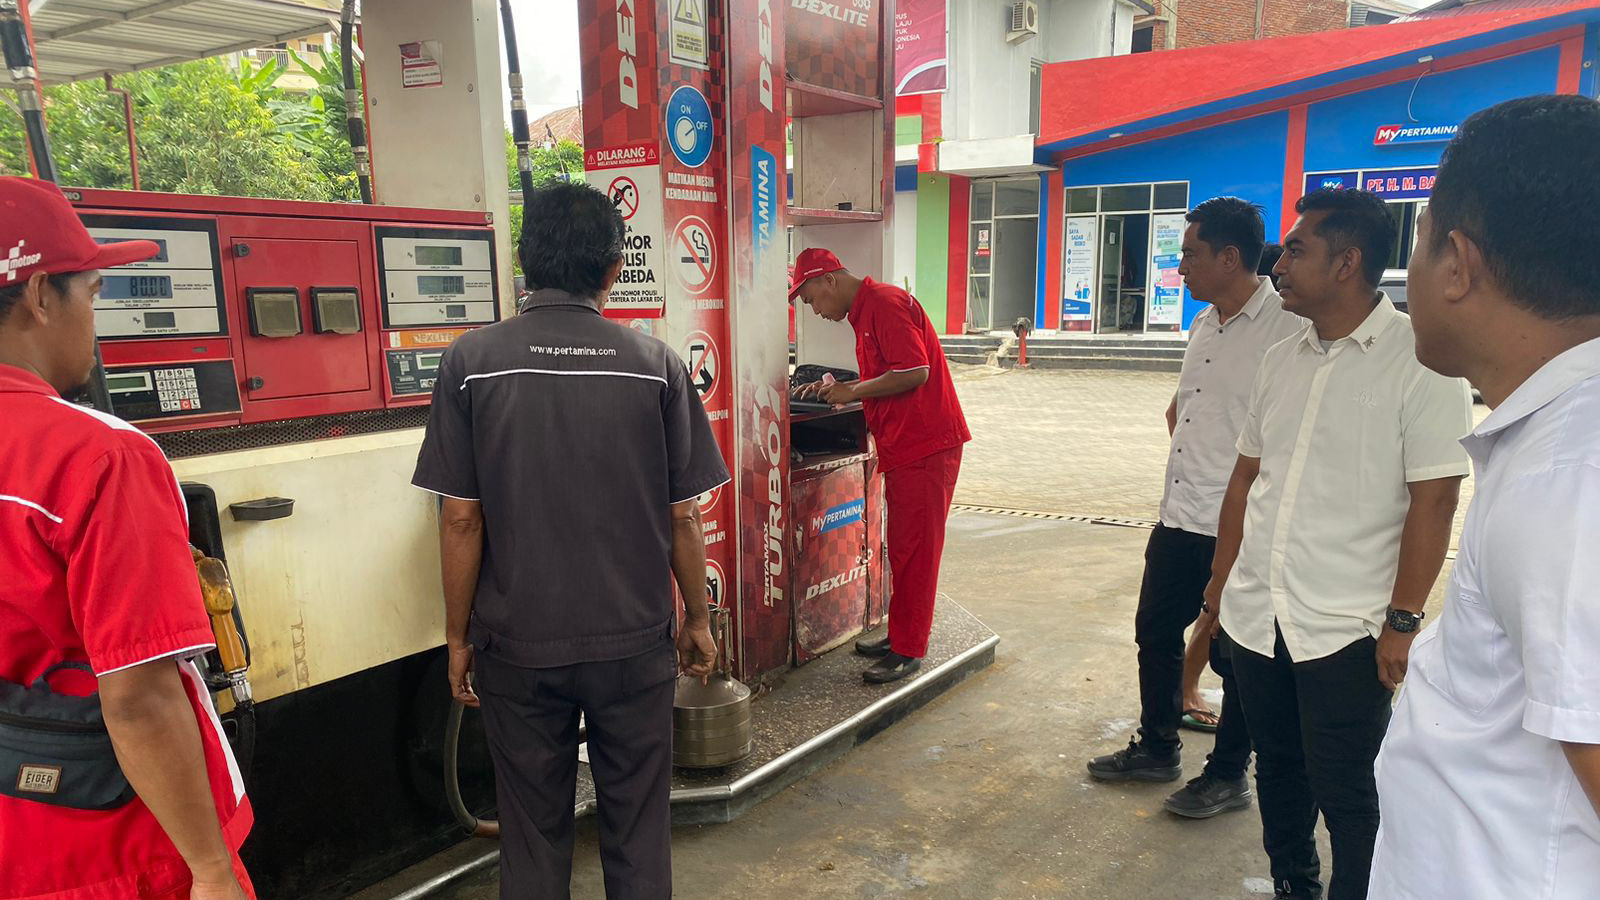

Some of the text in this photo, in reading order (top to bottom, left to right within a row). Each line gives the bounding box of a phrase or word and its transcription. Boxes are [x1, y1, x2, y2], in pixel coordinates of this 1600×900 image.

[792, 0, 869, 28] DEXLITE
[896, 34, 920, 42] ONESIA
[681, 105, 691, 114] ON
[696, 121, 708, 130] OFF
[596, 147, 646, 161] DILARANG
[667, 172, 714, 188] MATIKAN MESIN
[1367, 179, 1384, 192] PT.
[1387, 178, 1399, 191] H.
[1403, 177, 1416, 190] M.
[665, 188, 718, 203] KENDARAAN ANDA
[621, 235, 652, 250] MOR
[623, 252, 646, 267] LISI
[615, 269, 655, 283] RBEDA
[529, 345, 617, 357] www.pertamina.com
[768, 421, 783, 607] TURBO
[806, 562, 870, 600] DEXLITE
